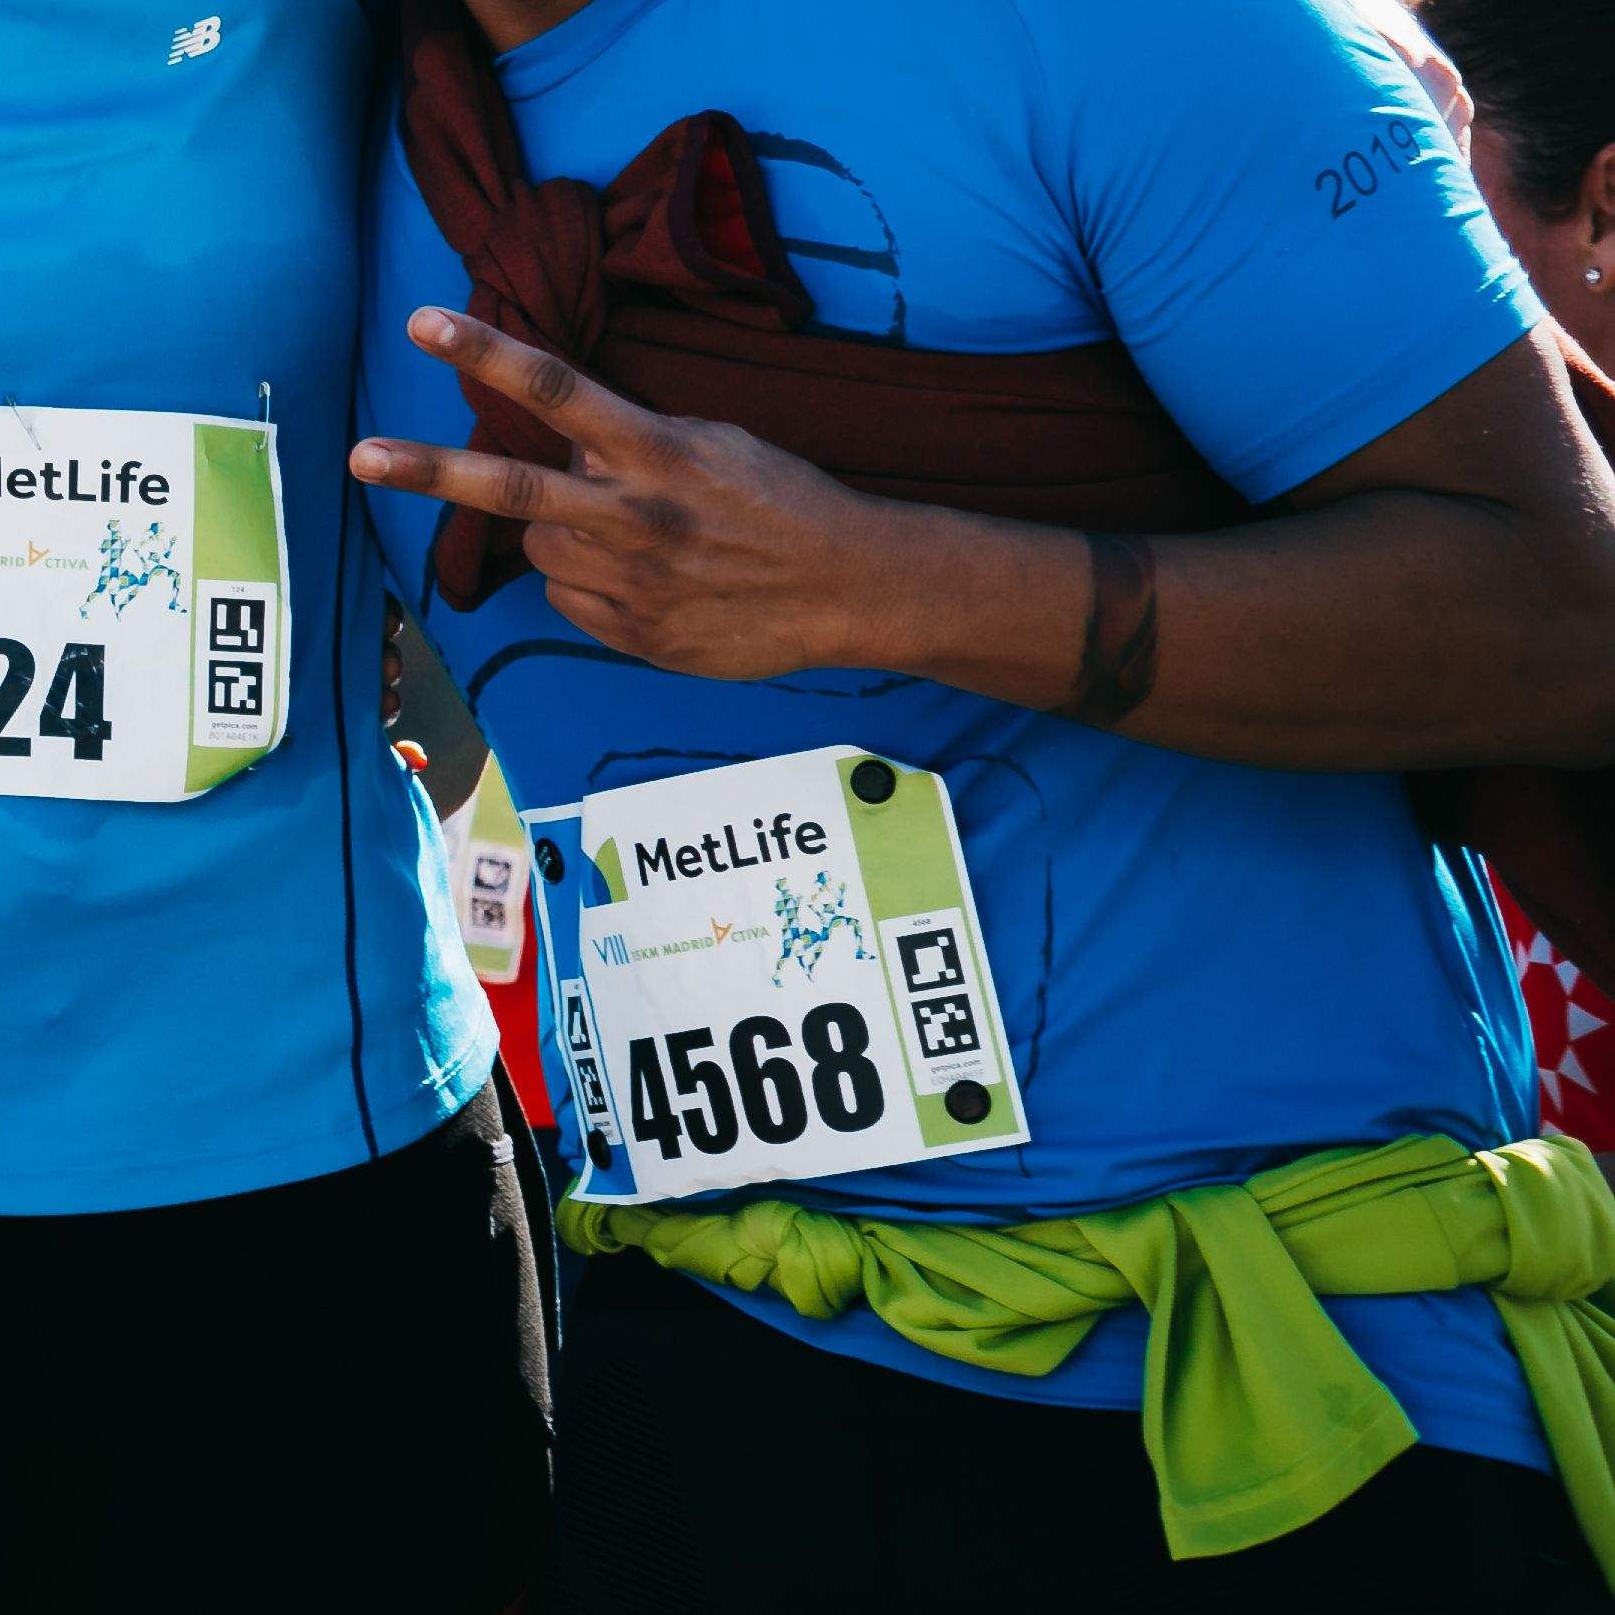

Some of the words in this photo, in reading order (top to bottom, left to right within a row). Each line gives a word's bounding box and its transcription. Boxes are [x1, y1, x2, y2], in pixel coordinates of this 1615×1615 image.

[1313, 119, 1420, 220] 2019
[633, 812, 828, 887] MetLife
[591, 933, 630, 967] VIII
[662, 936, 715, 957] MADRID
[628, 1002, 885, 1161] 4568
